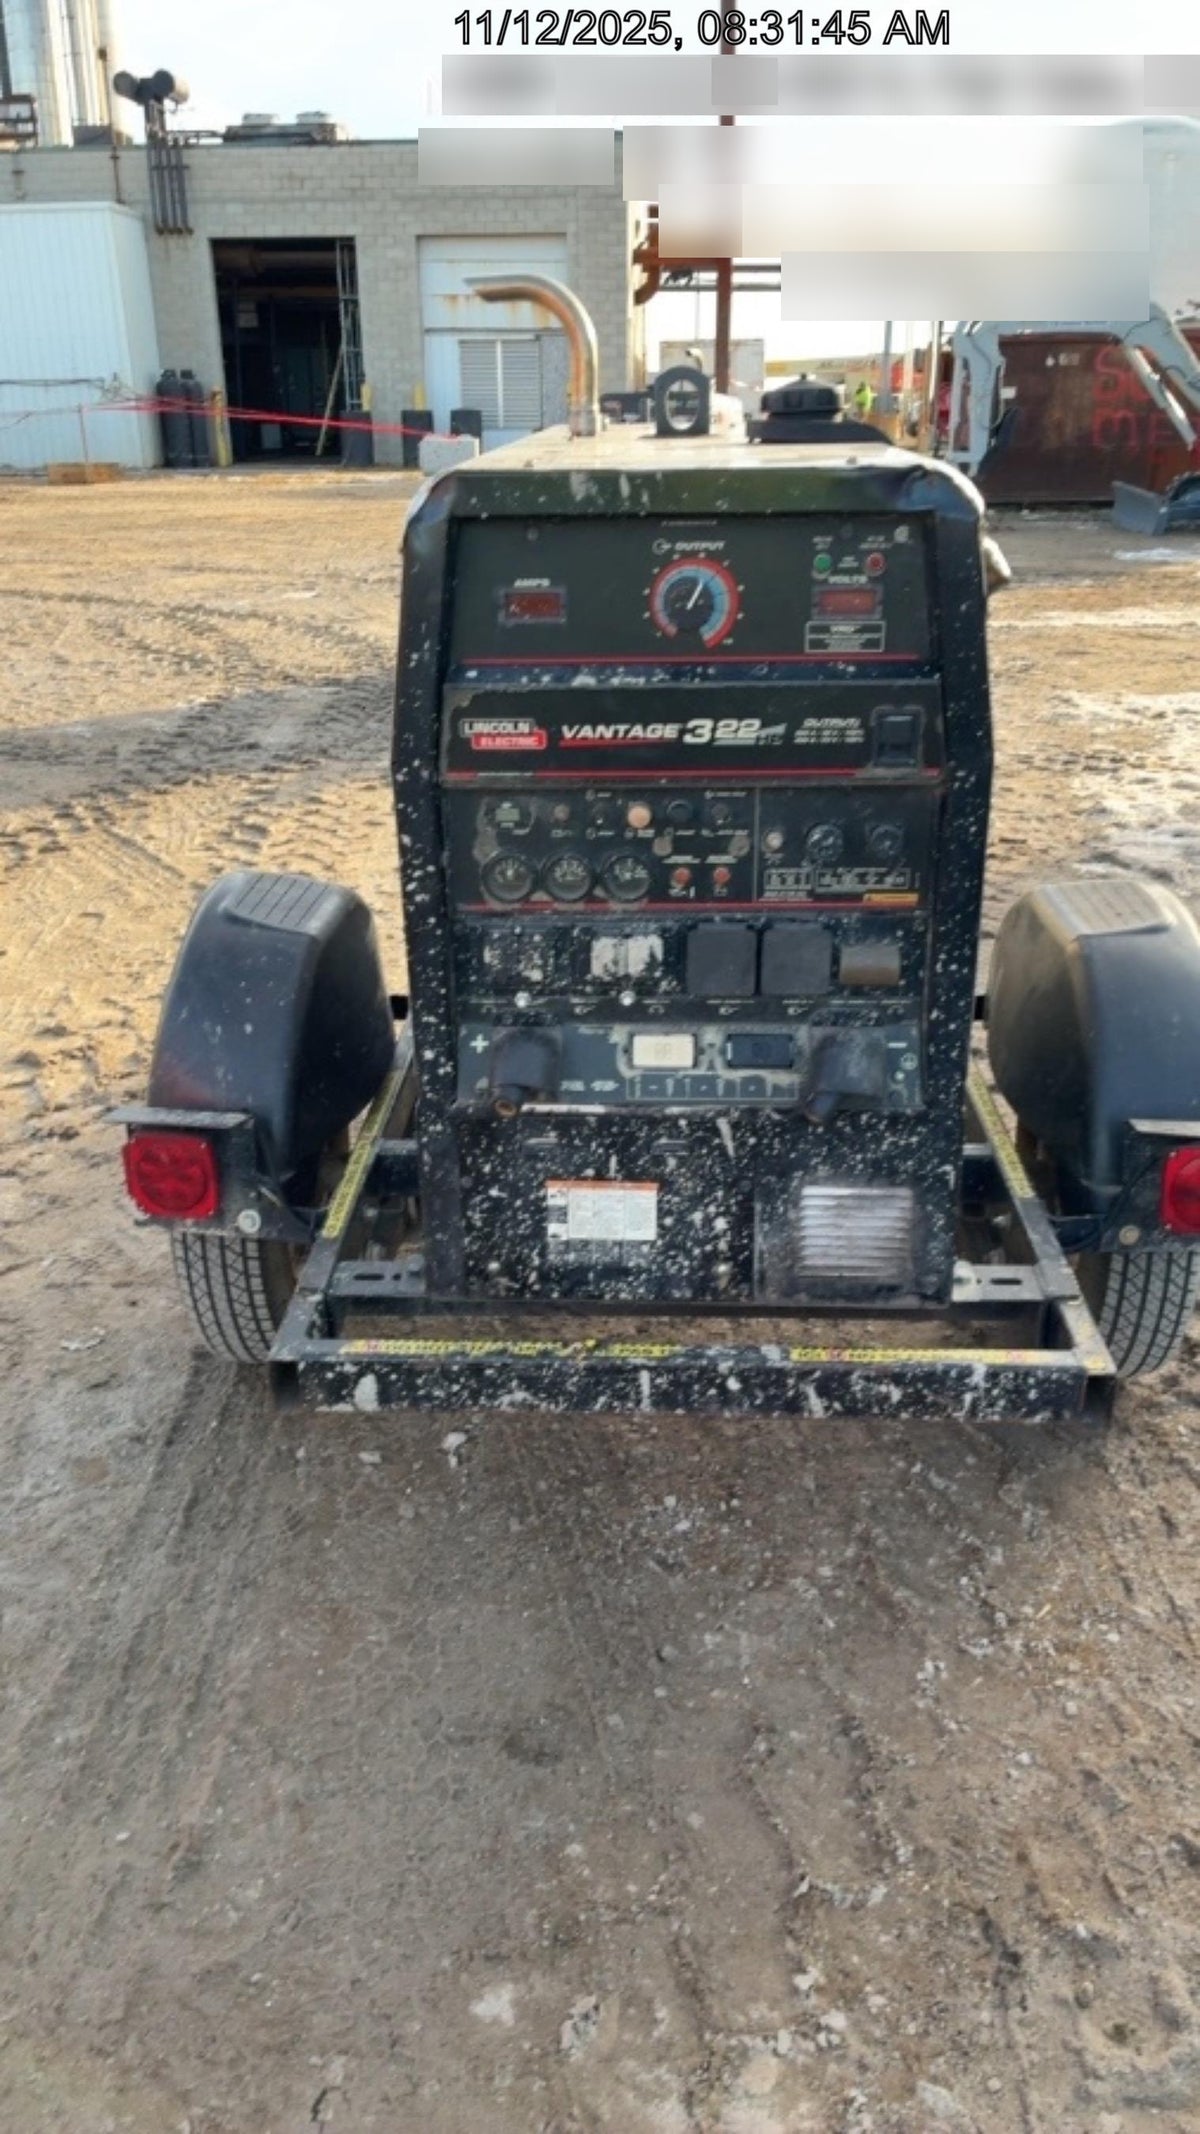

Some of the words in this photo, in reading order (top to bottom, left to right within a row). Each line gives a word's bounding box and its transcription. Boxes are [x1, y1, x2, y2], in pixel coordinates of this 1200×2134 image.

[674, 541, 726, 551] OUTPUT
[514, 578, 550, 588] AMPS
[828, 575, 868, 584] VOLTS
[464, 722, 530, 734] LINCOLN
[561, 724, 684, 739] VANTAGE
[683, 718, 762, 744] 322
[479, 736, 540, 746] ELECTRIC
